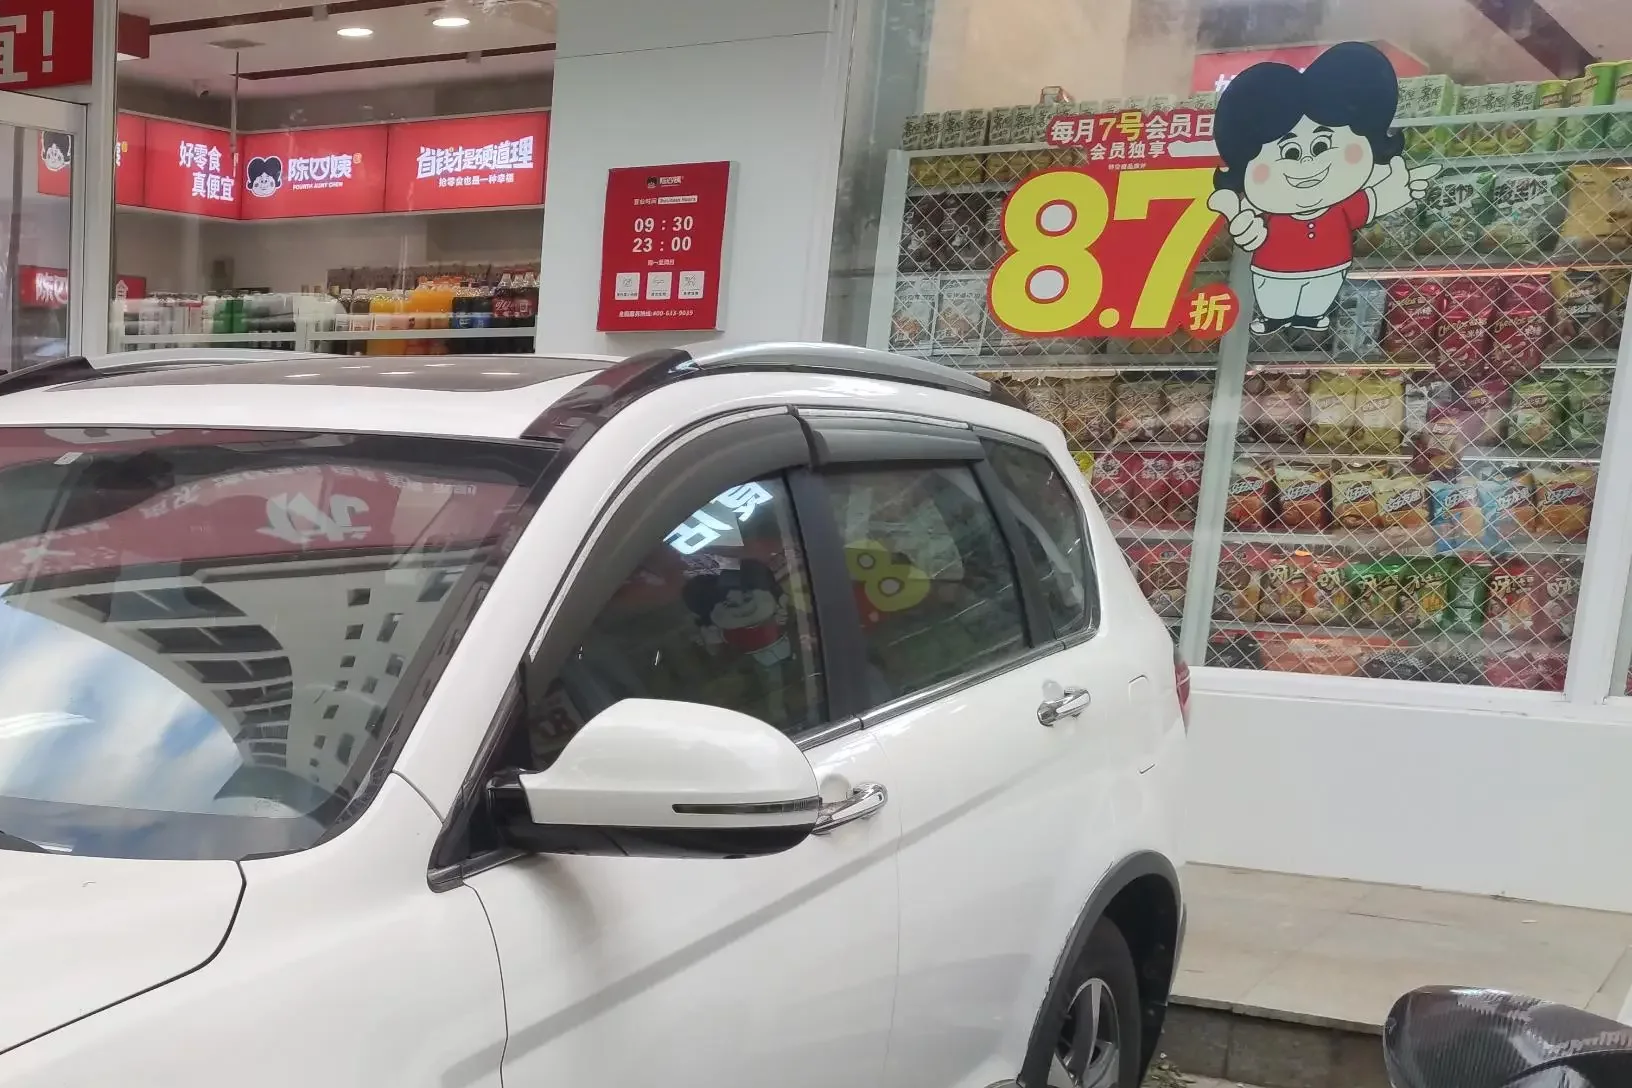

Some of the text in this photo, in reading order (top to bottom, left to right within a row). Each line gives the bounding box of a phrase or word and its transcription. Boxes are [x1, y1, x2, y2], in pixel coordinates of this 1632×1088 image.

[1050, 111, 1215, 144] 每月7号会员日
[179, 140, 222, 172] 好零食
[416, 135, 534, 179] 省钱才是硬道理
[1090, 141, 1167, 161] 会员独享
[288, 153, 353, 182] 陈四姨
[191, 172, 235, 201] 真便宜
